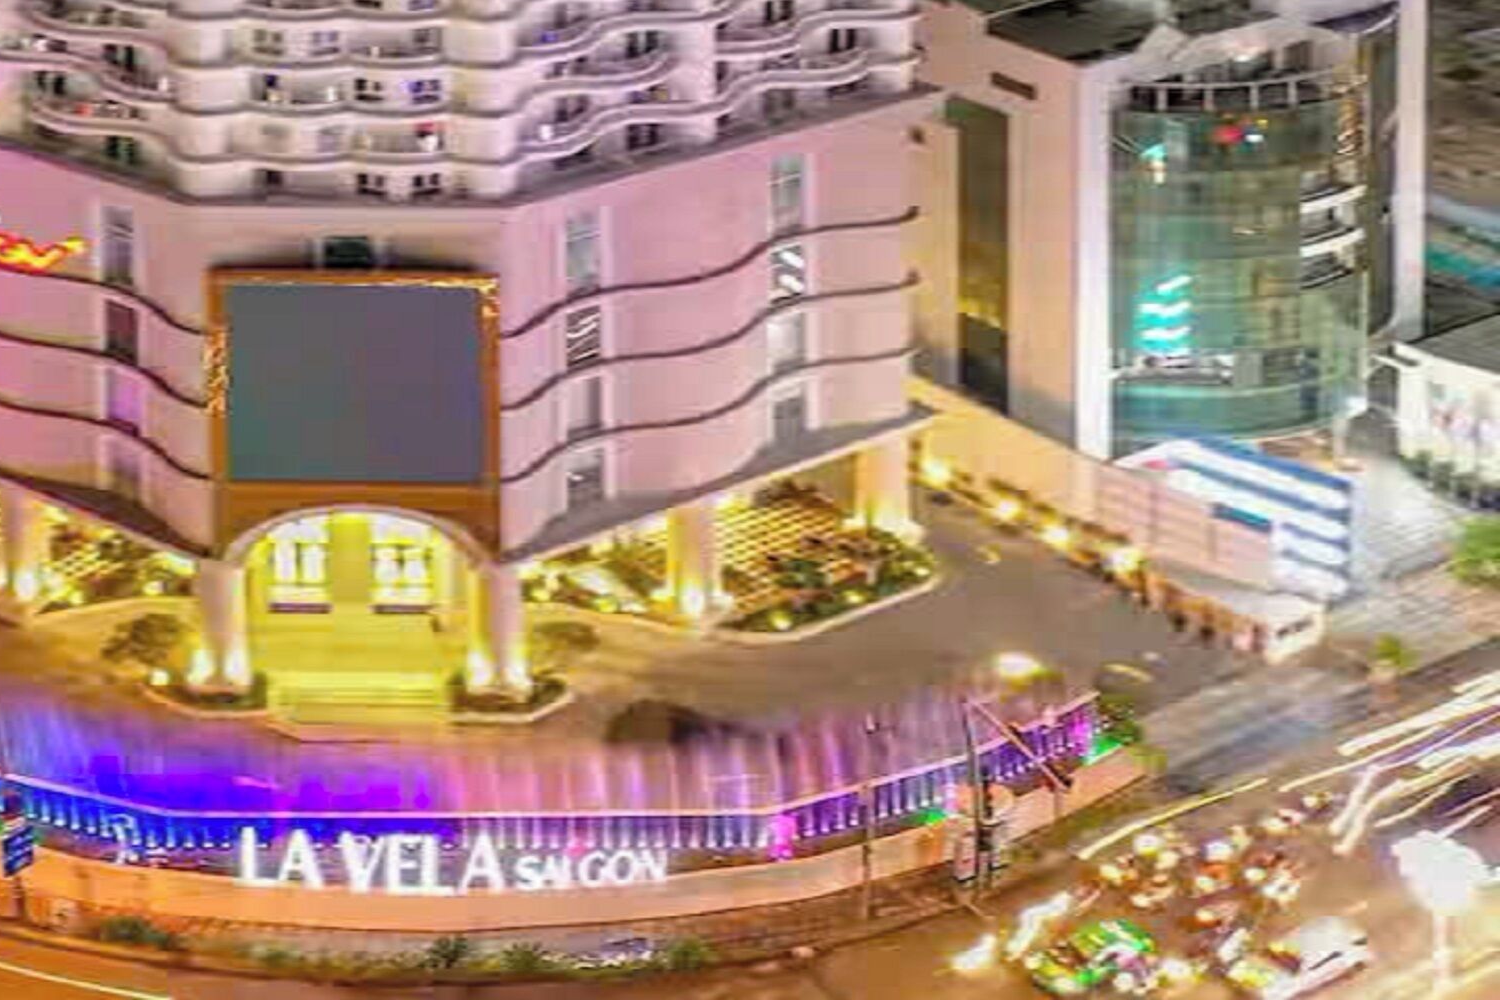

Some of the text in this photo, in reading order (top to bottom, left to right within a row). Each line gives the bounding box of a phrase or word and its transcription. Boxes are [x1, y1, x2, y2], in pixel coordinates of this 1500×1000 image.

[233, 826, 668, 897] LA VELA SAIGON
